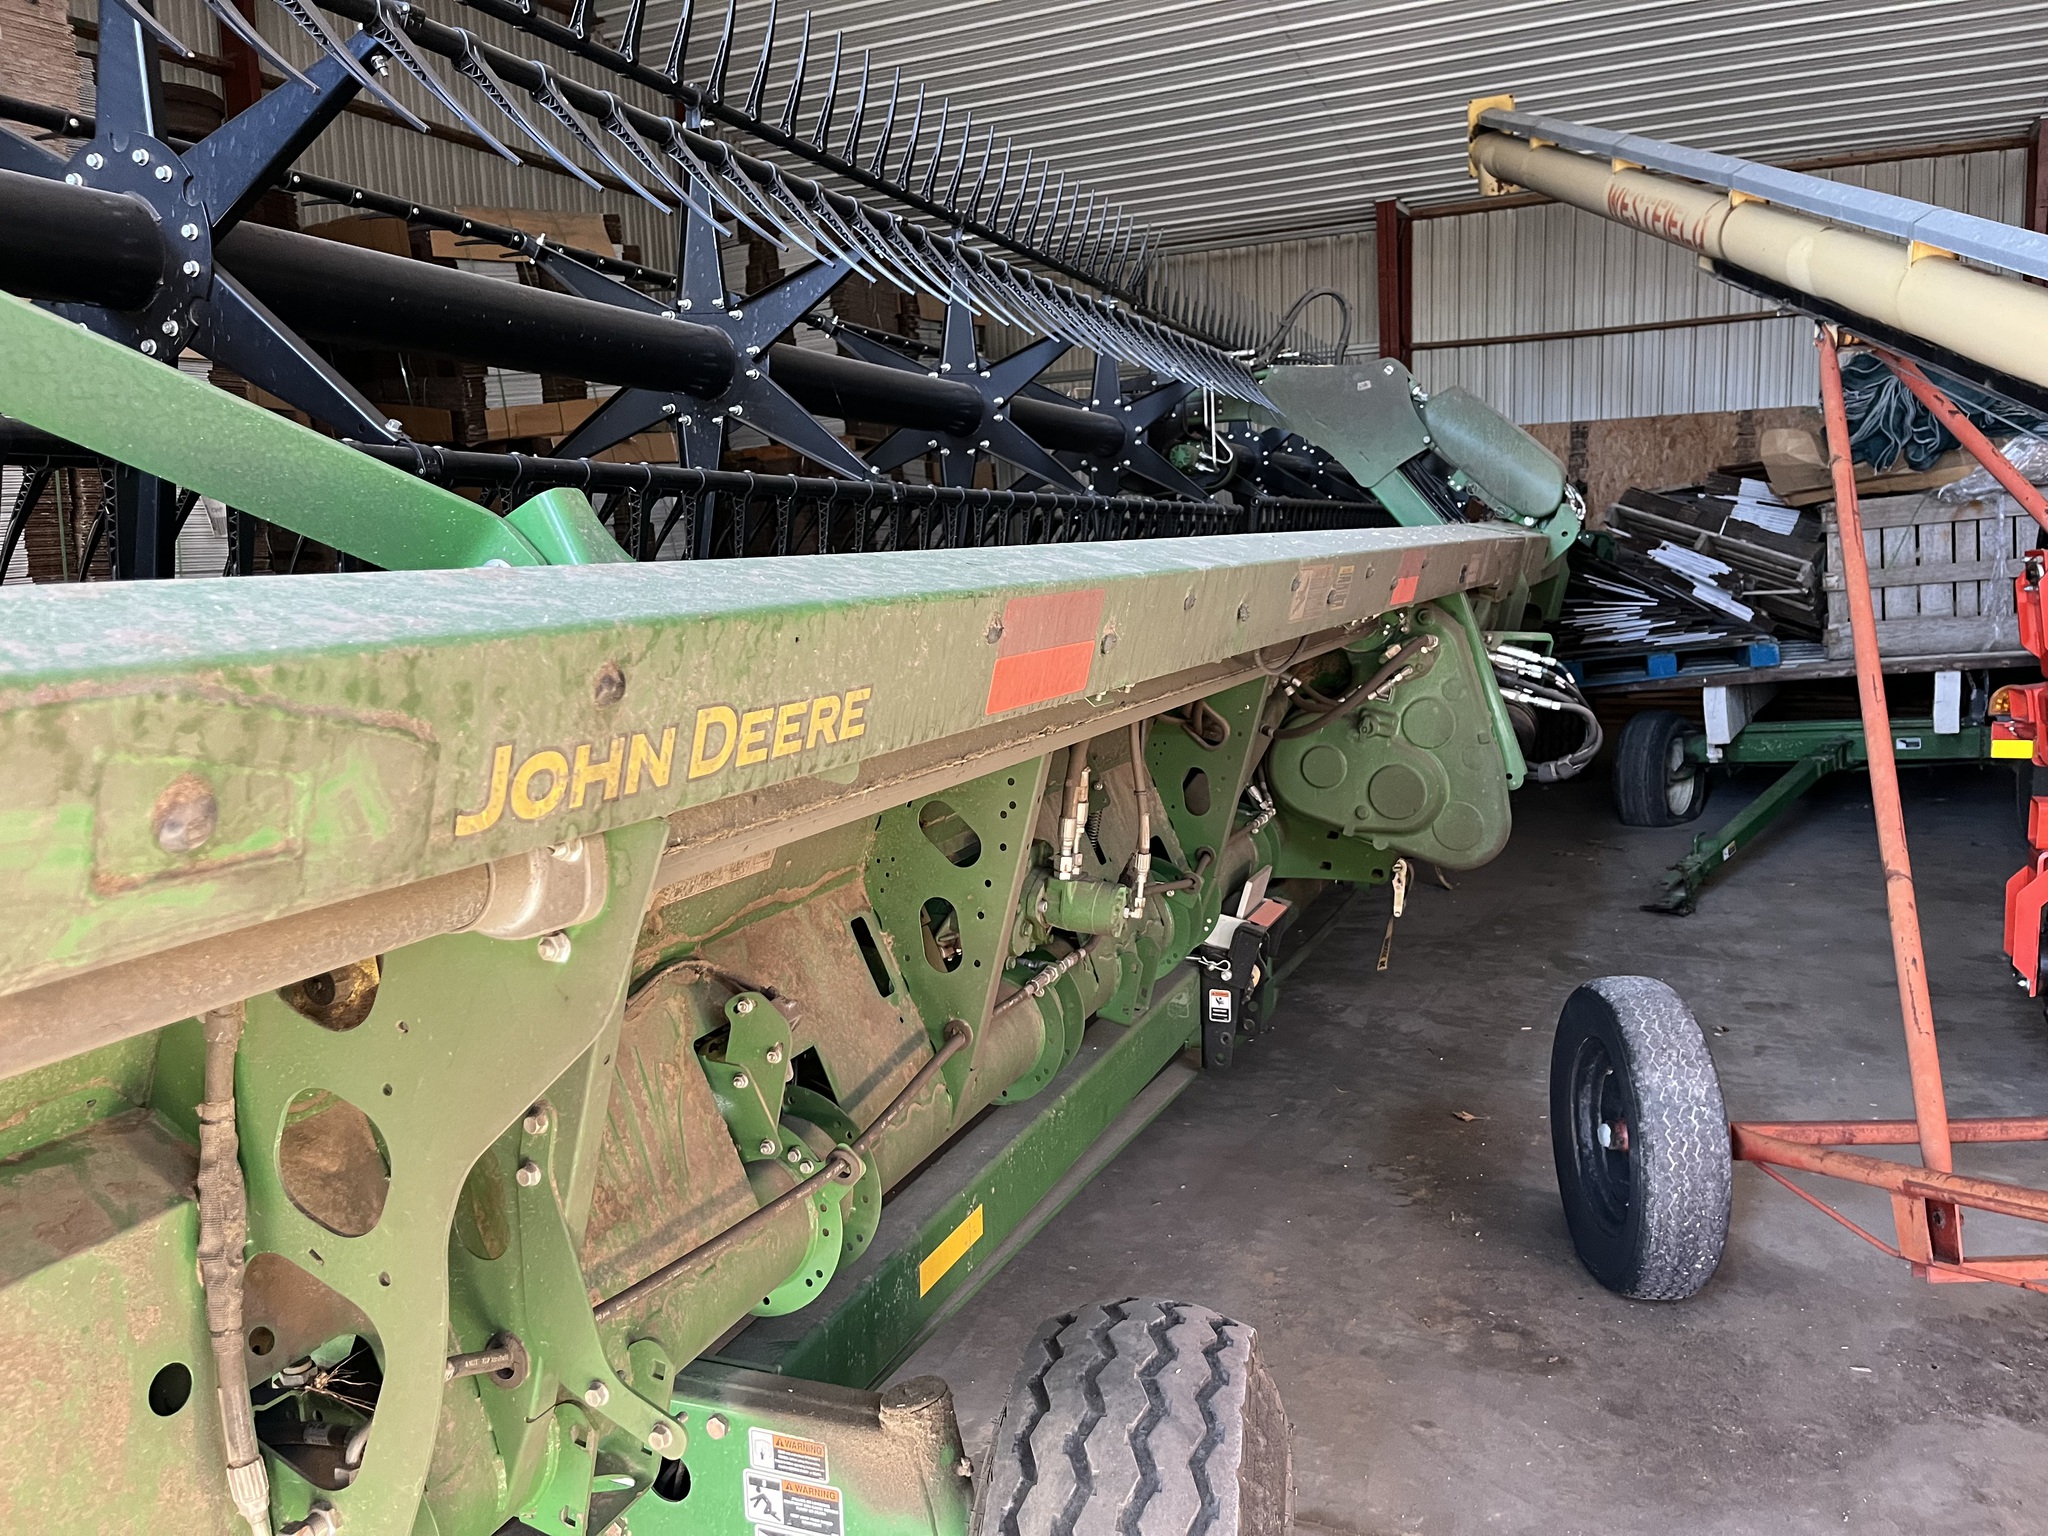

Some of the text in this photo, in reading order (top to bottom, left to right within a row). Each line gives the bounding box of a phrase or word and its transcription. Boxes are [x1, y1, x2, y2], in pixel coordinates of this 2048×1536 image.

[455, 686, 872, 836] JOHN DEERE
[784, 1440, 823, 1455] WARNING
[794, 1483, 836, 1500] WARNING
